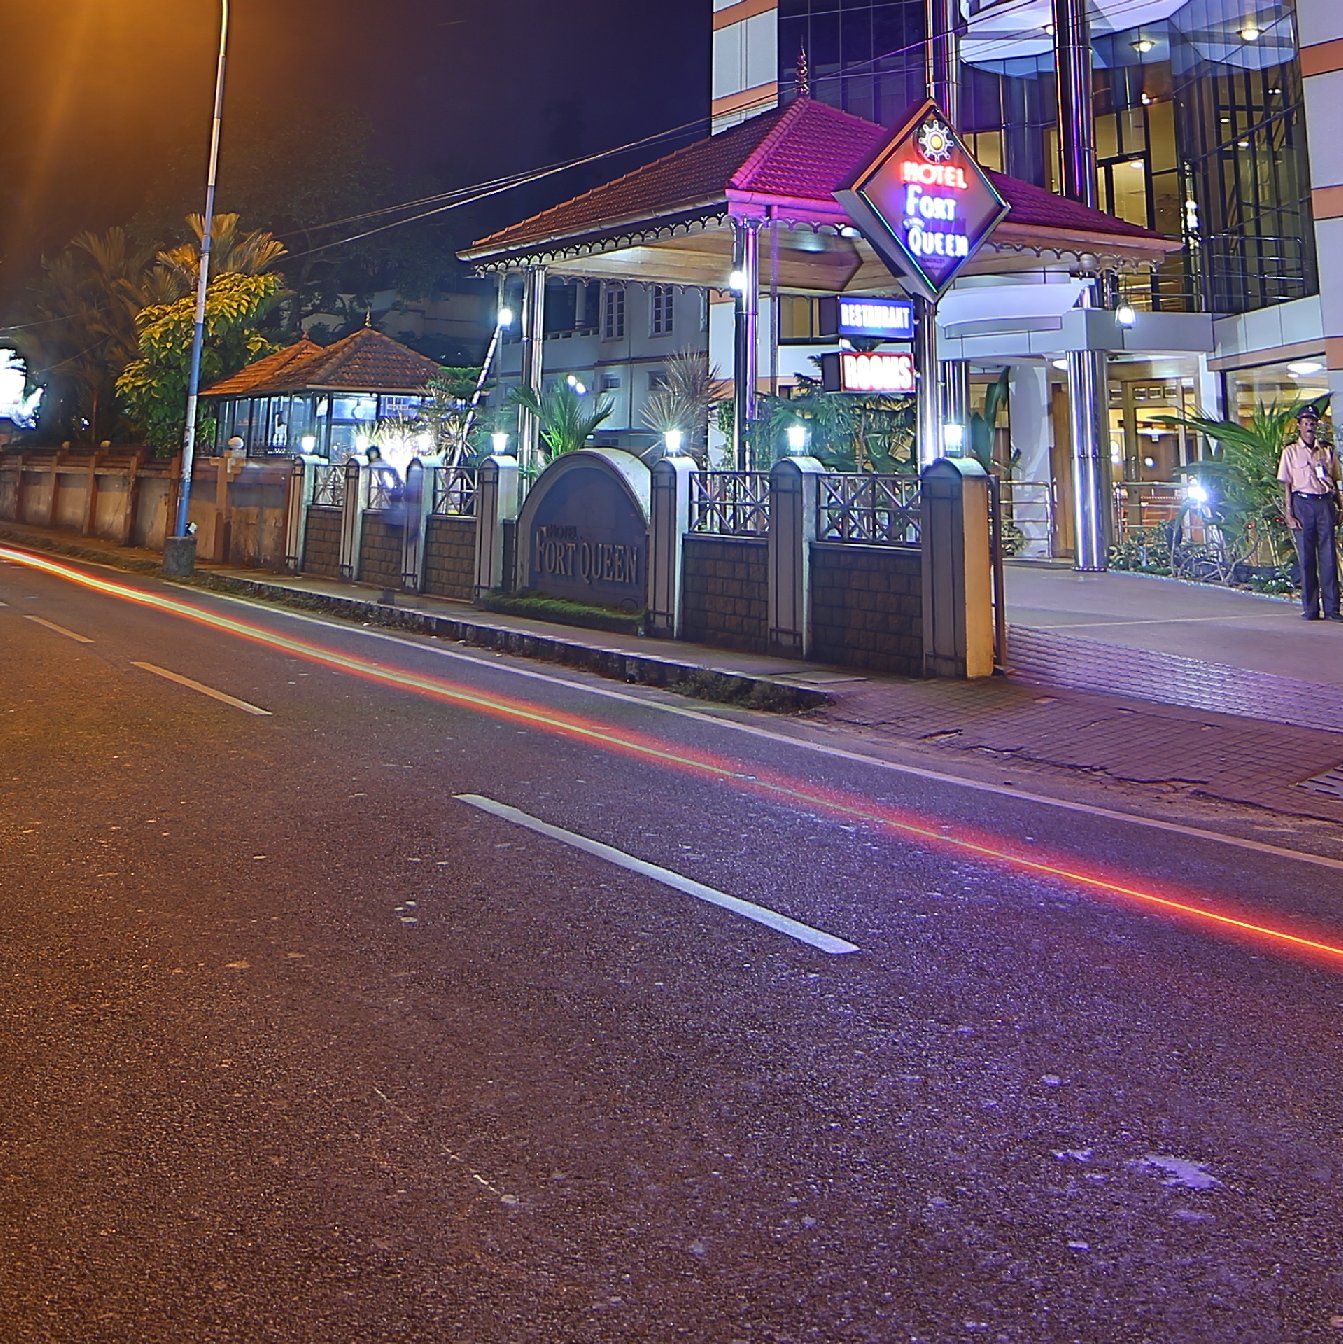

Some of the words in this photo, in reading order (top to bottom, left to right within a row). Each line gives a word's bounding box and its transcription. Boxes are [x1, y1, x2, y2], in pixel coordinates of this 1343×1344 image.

[901, 161, 968, 189] HOTEL
[535, 526, 576, 575] FORT
[579, 542, 638, 584] QUEEN
